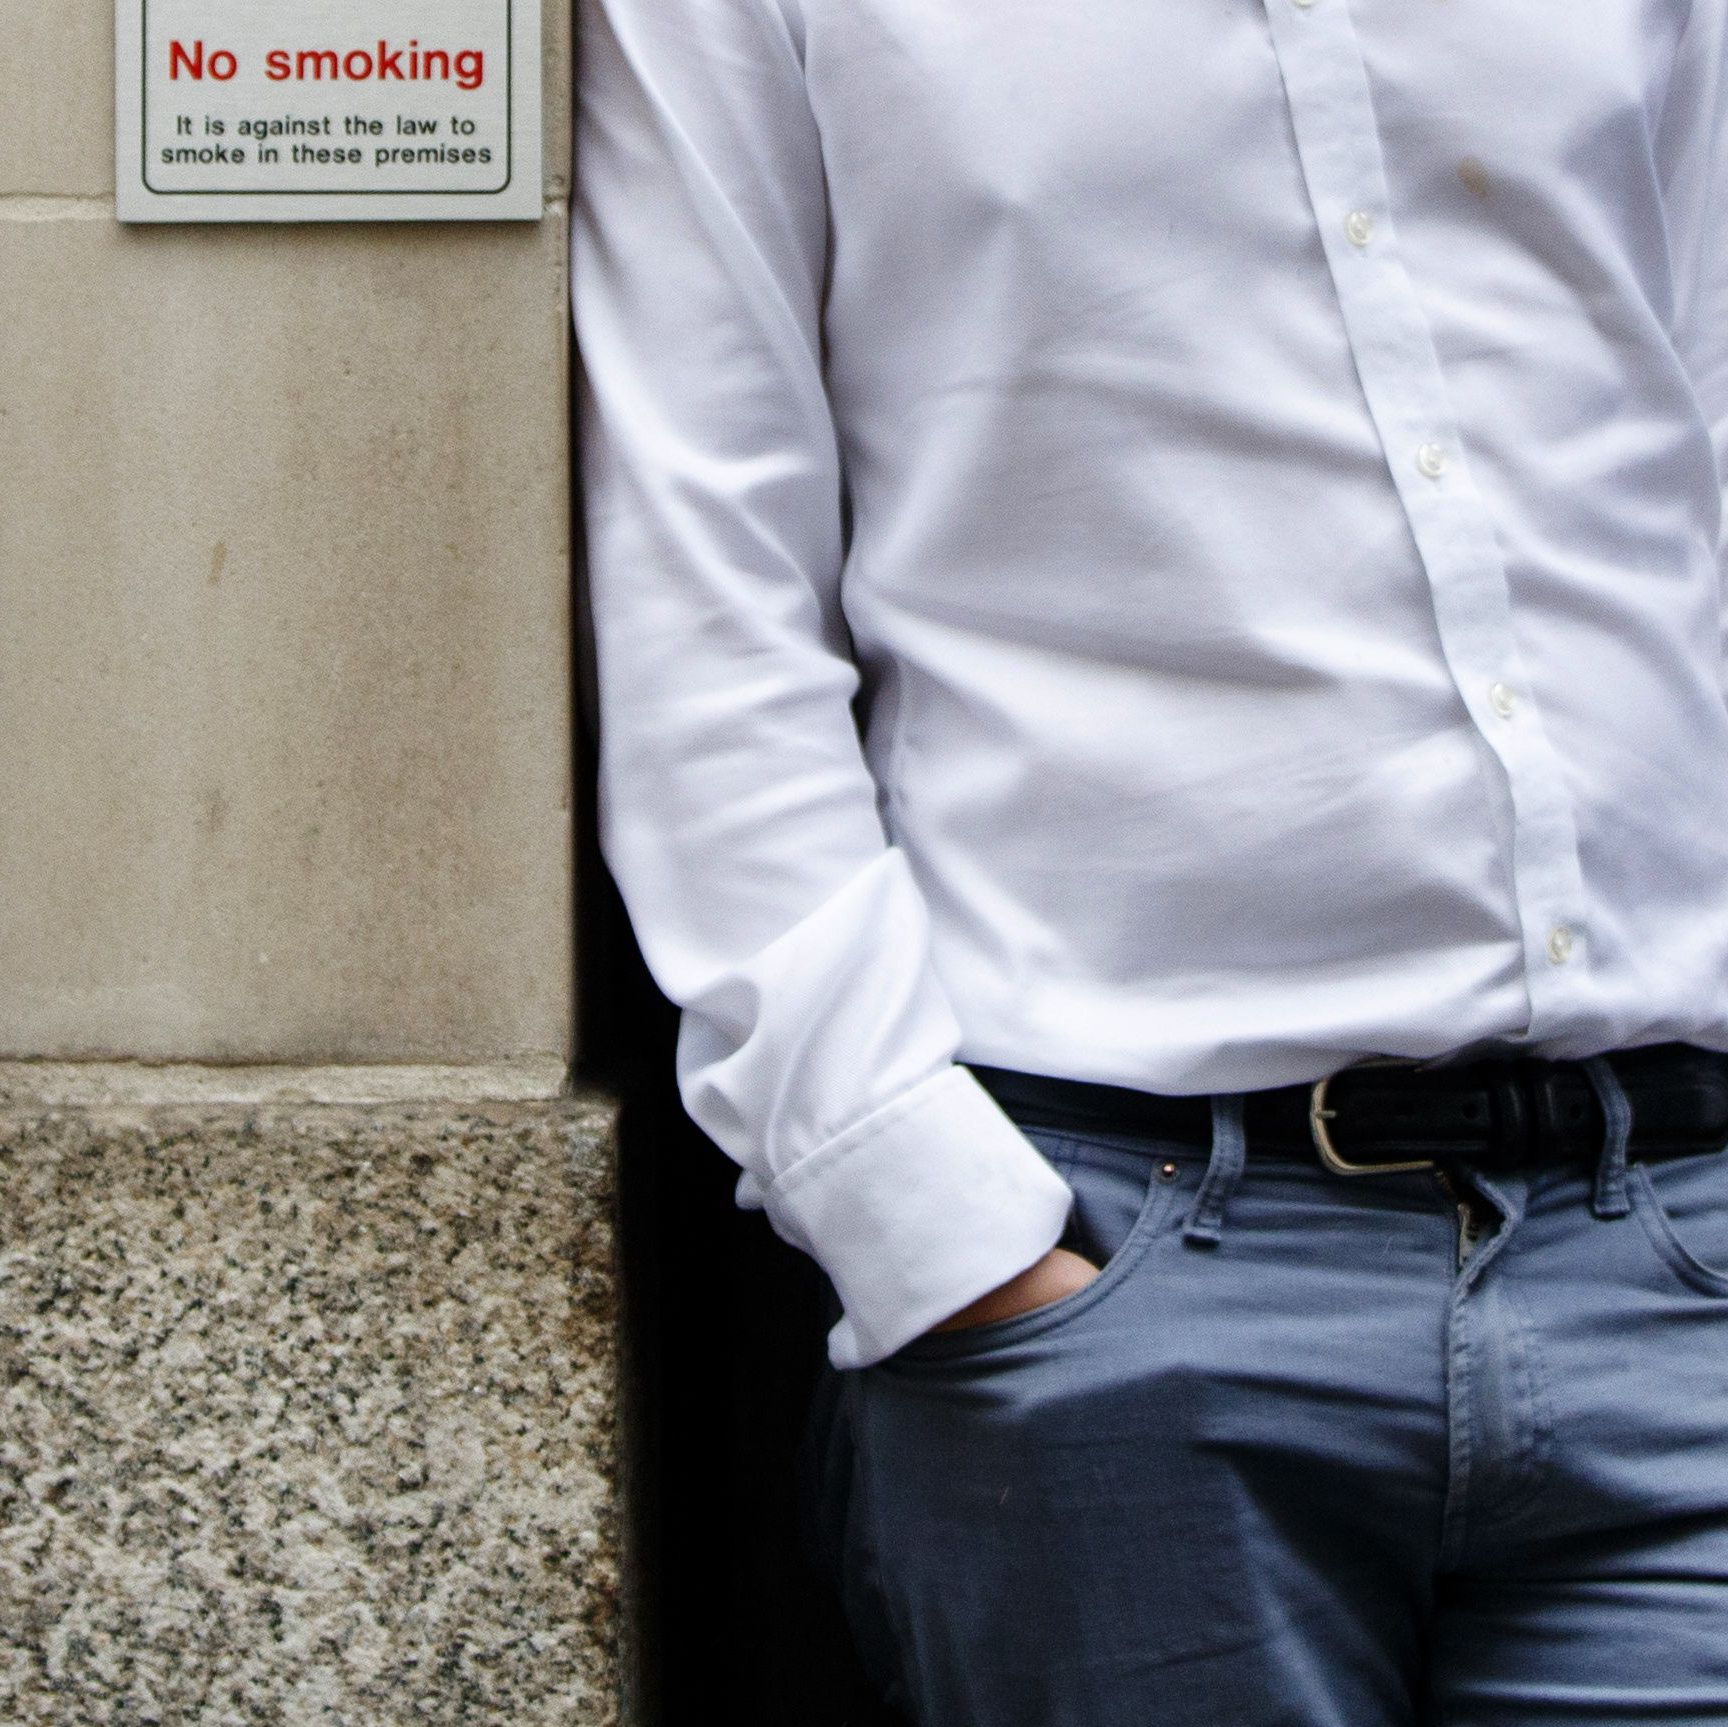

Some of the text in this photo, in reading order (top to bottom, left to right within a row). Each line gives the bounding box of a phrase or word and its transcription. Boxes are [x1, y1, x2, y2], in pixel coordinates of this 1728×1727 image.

[169, 39, 485, 90] No smoking
[177, 114, 476, 141] It is against the law to
[161, 142, 492, 168] smoke in these premises
